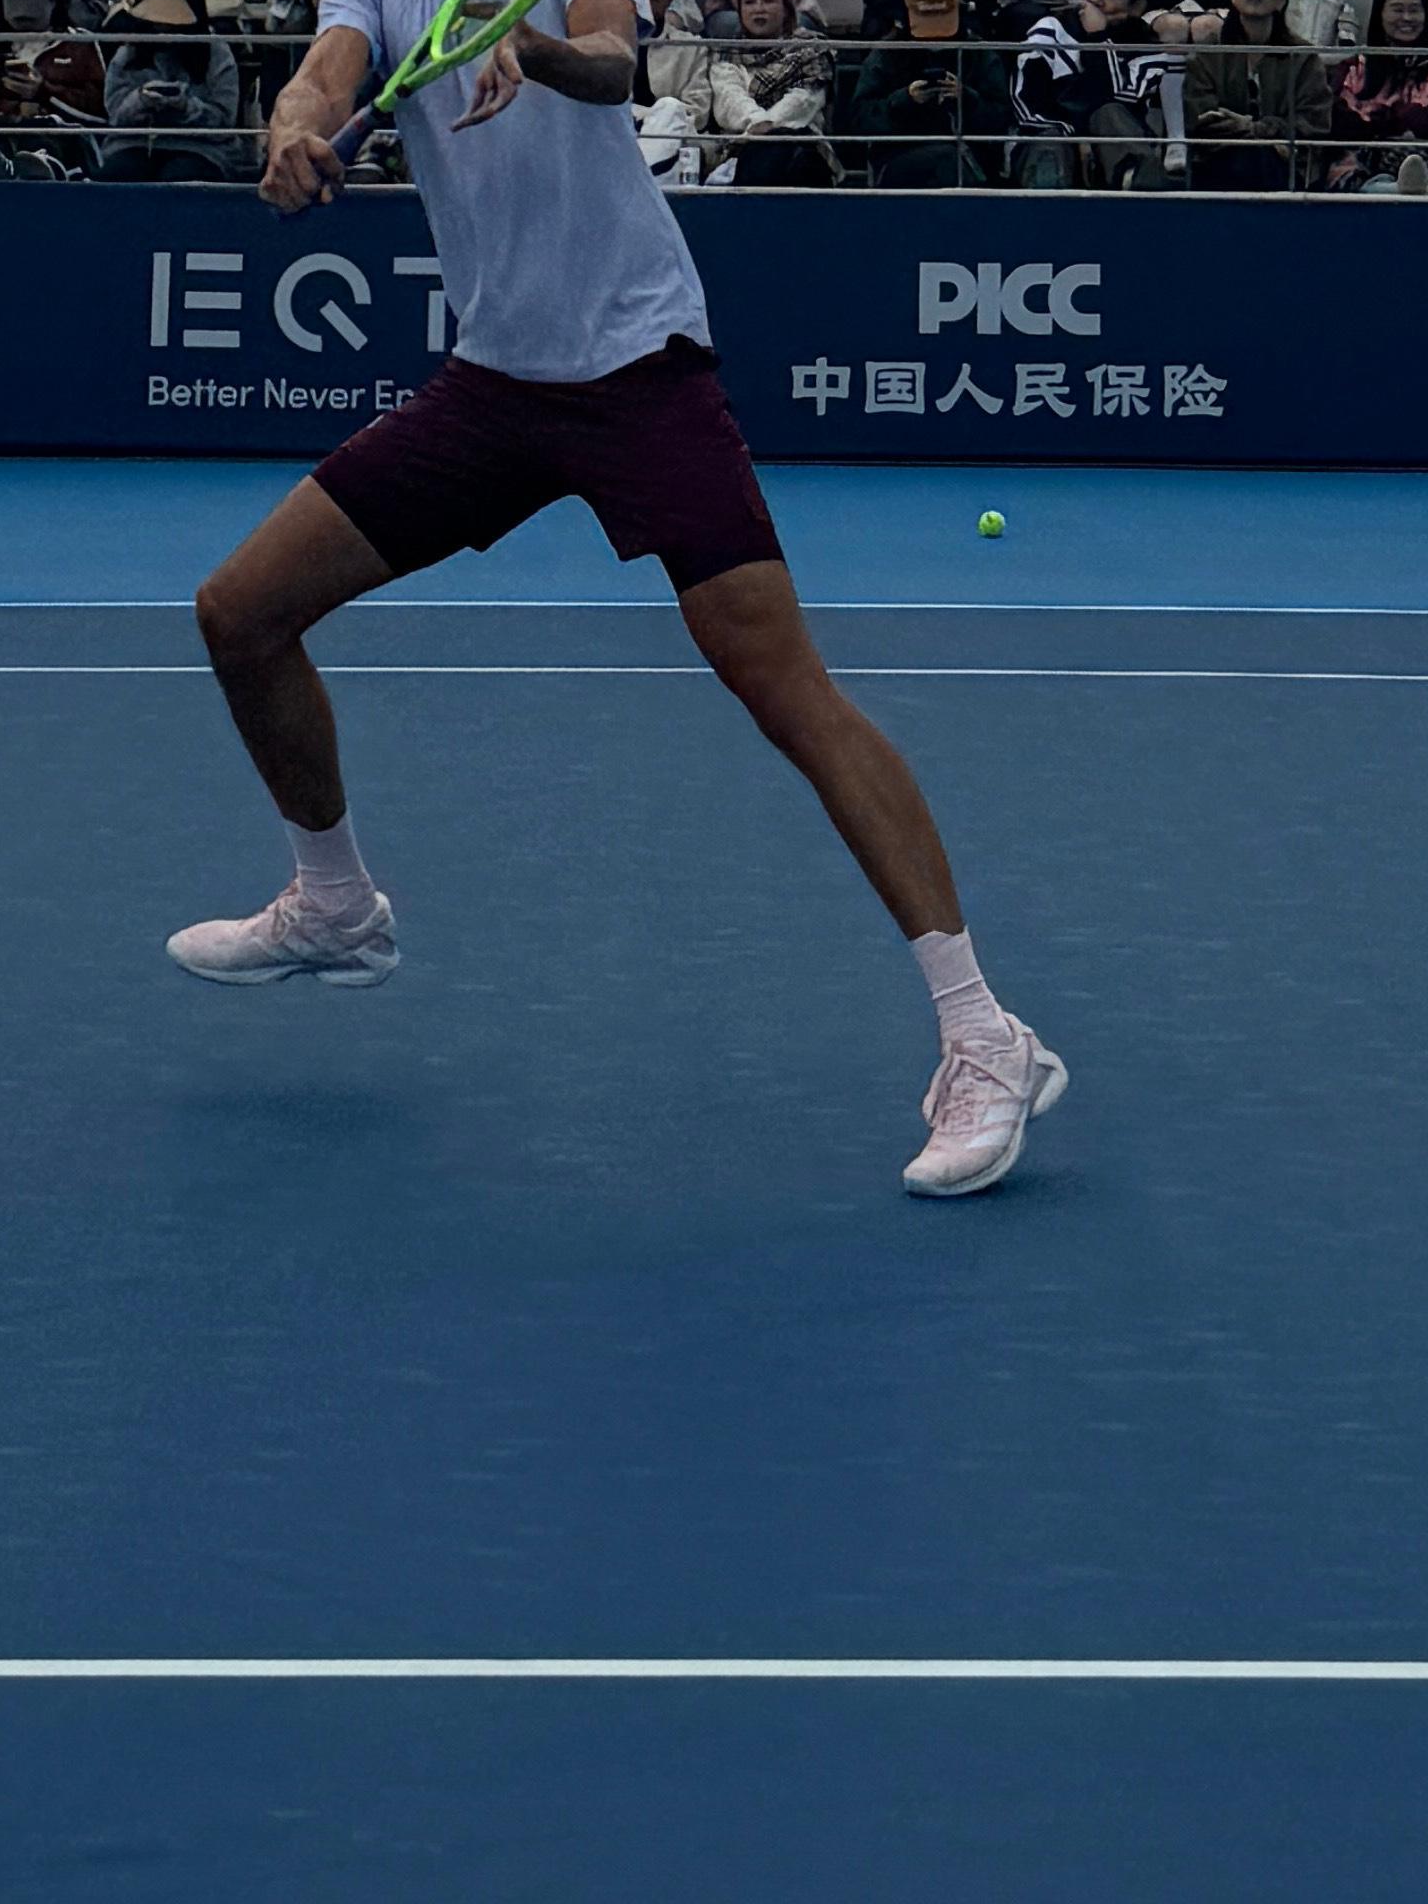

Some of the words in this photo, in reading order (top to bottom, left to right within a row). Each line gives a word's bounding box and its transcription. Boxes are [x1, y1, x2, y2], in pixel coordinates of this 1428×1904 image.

[151, 251, 450, 353] EQT
[918, 261, 1102, 336] PICC
[148, 375, 255, 408] Better
[264, 377, 366, 410] Never
[375, 379, 415, 411] En
[791, 356, 1228, 418] 中国人民保险
